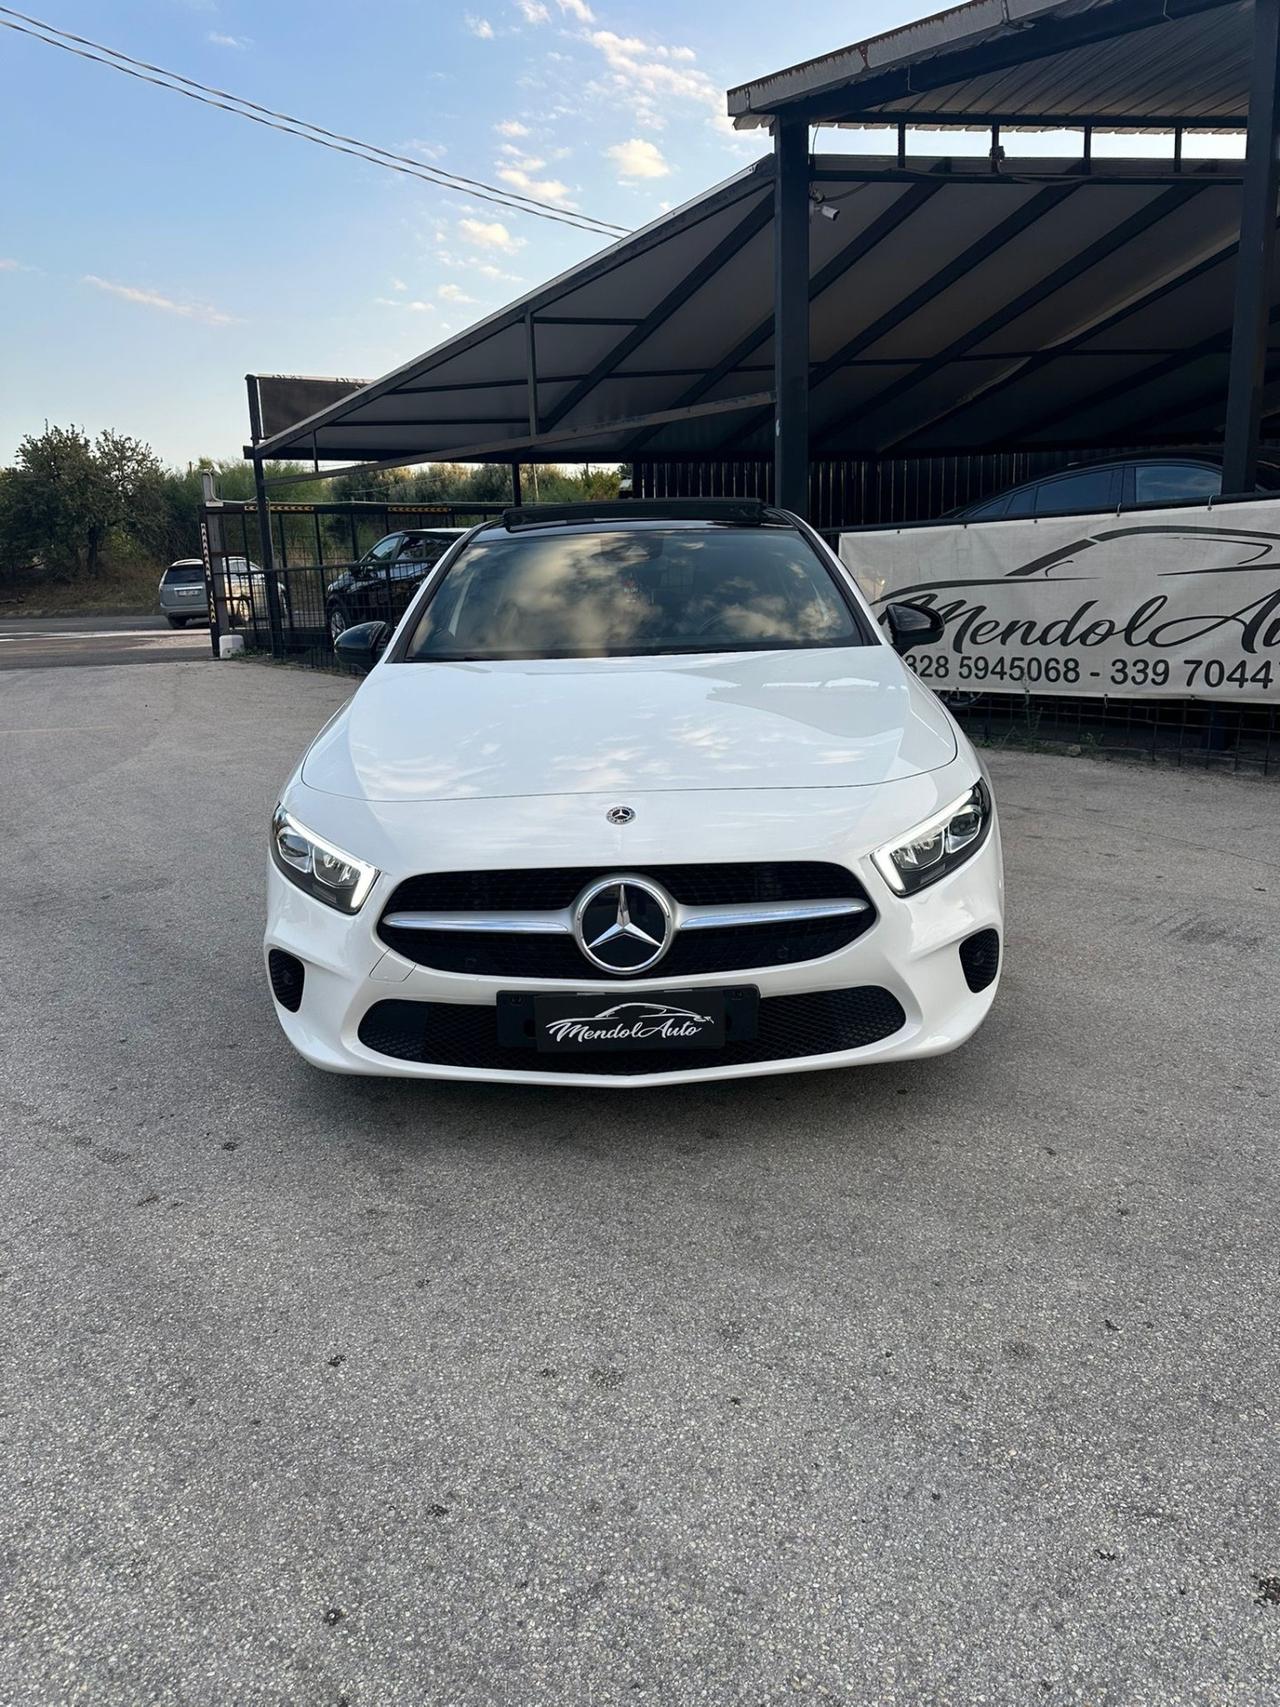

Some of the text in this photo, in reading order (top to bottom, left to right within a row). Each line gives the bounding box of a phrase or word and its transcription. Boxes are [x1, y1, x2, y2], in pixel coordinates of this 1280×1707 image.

[905, 655, 949, 678] 328
[959, 656, 1080, 683] 5945068
[1111, 659, 1169, 685] 339
[1183, 660, 1280, 689] 7044
